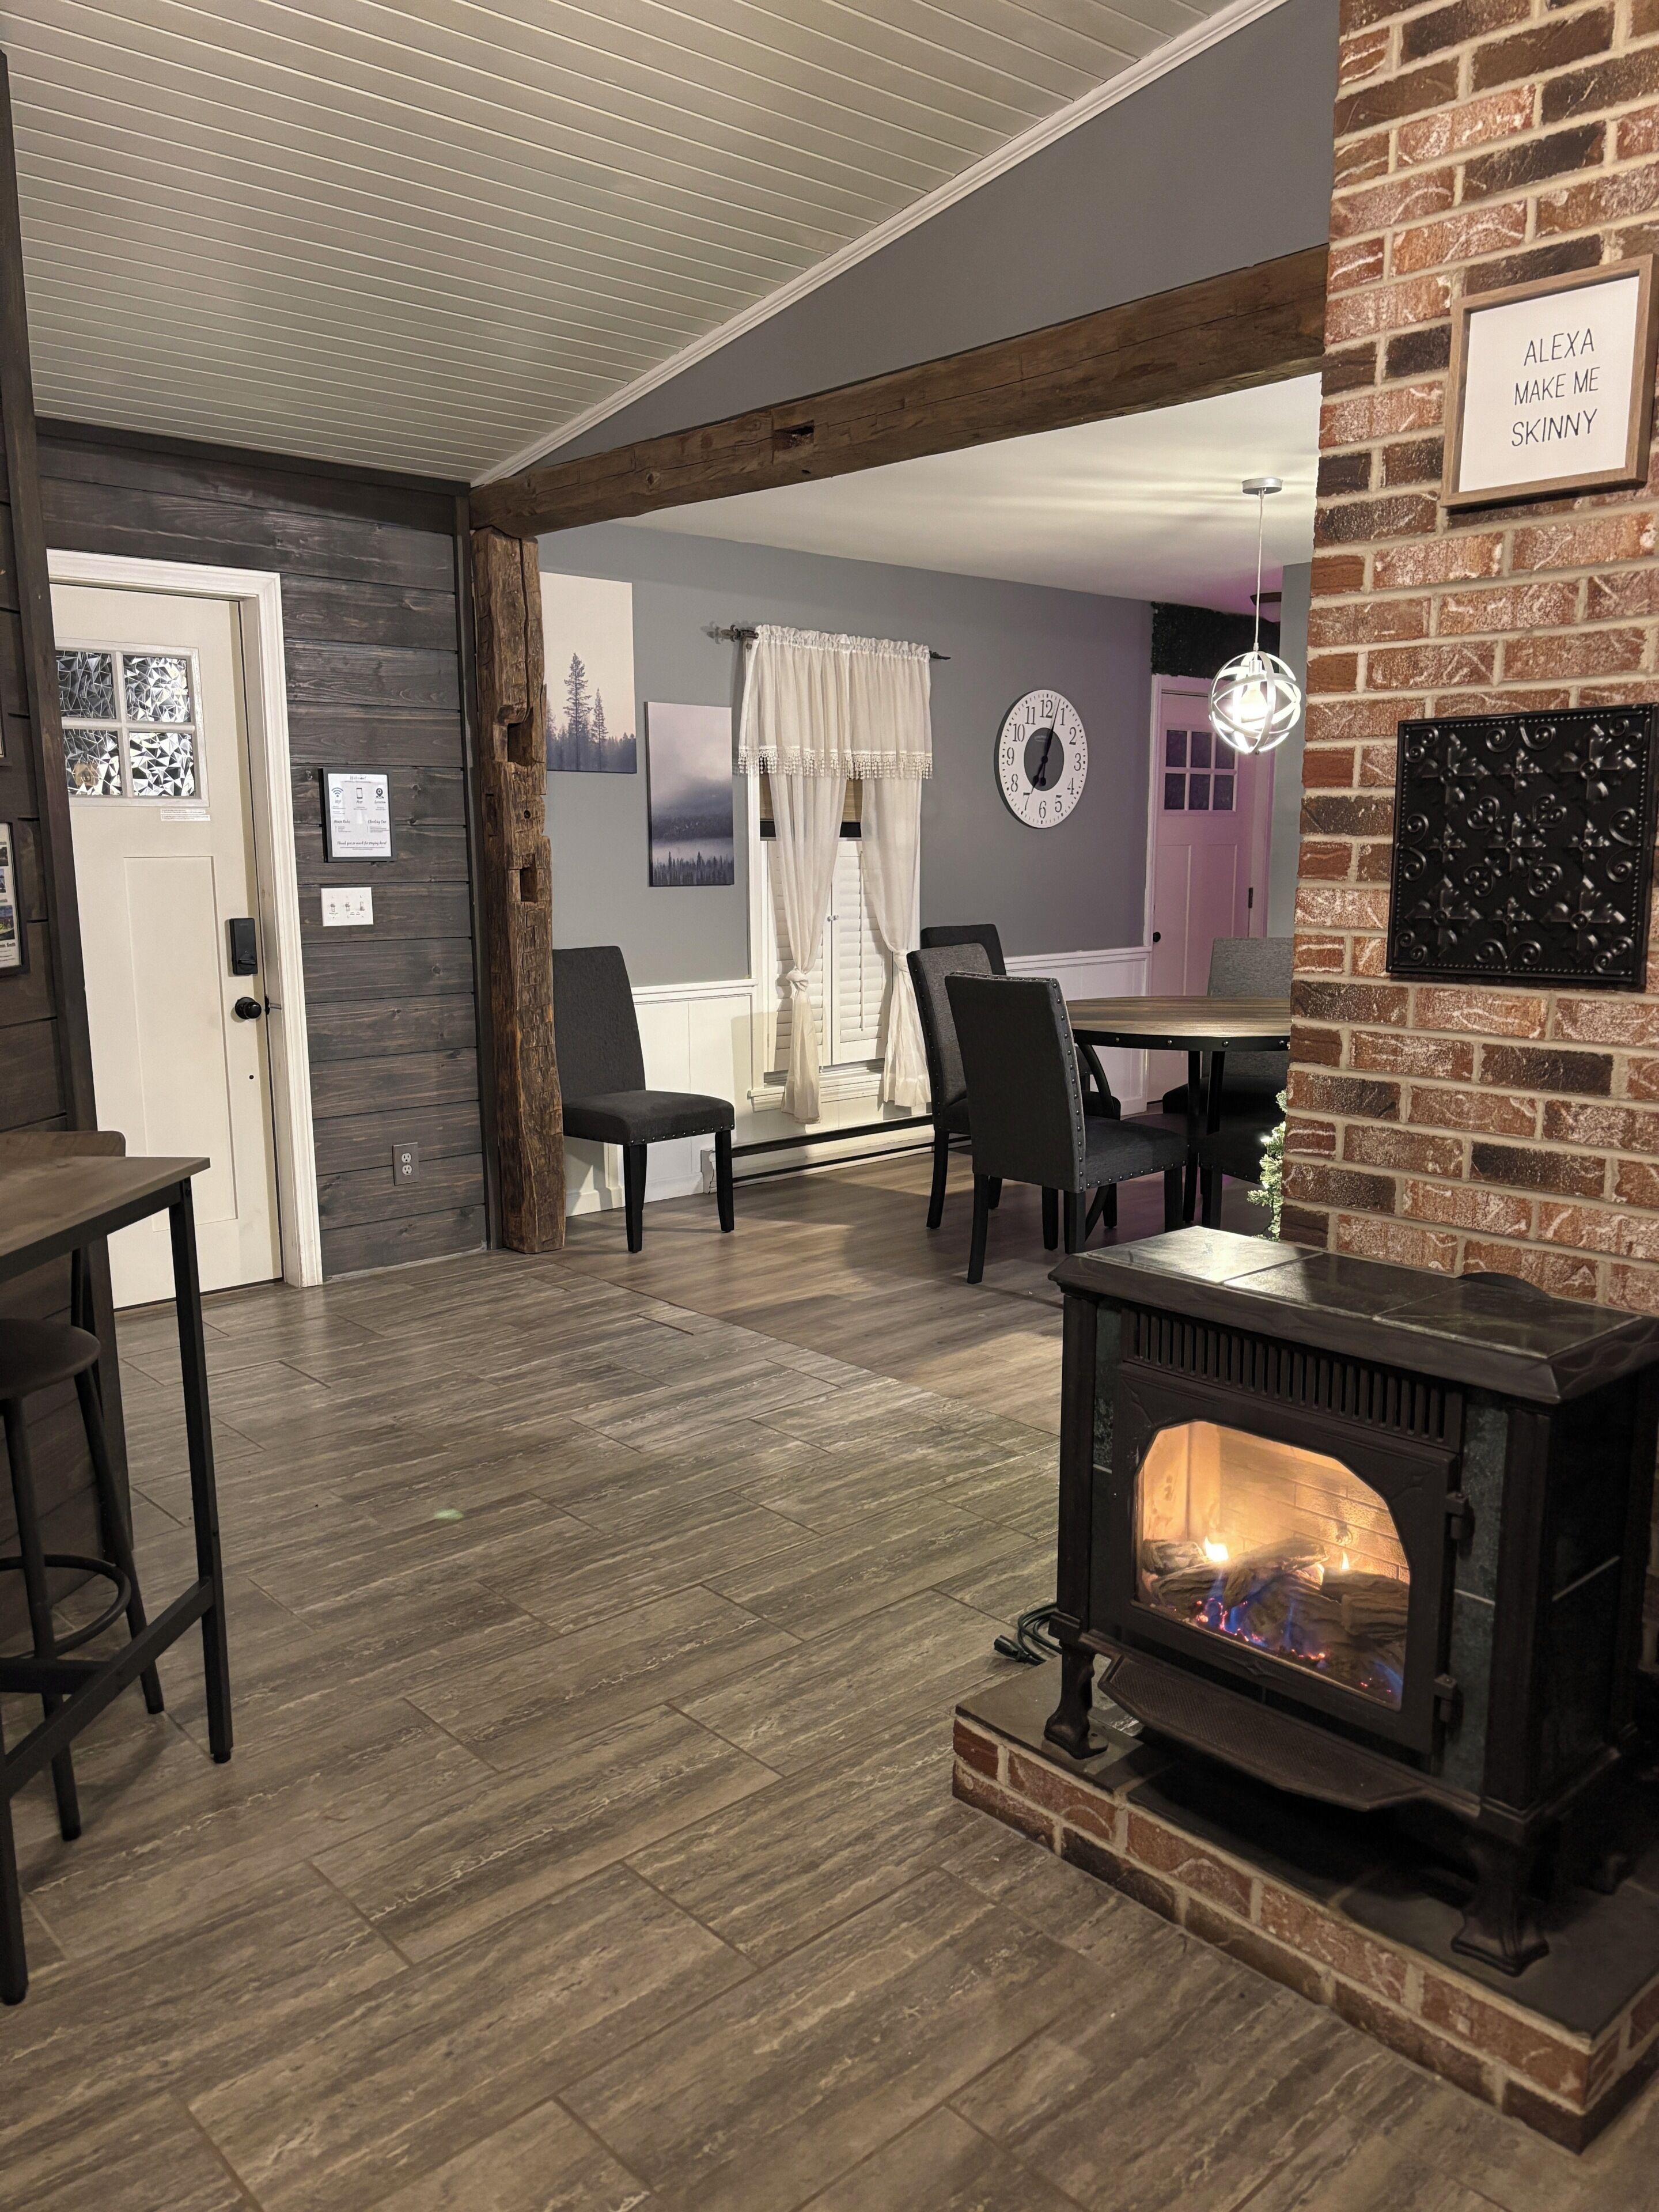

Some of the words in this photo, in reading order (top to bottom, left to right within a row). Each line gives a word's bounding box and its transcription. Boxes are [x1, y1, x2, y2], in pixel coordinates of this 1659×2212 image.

[1524, 328, 1595, 366] ALEXA
[1514, 373, 1567, 406] MAKE
[1573, 367, 1601, 395] ME
[1512, 408, 1598, 447] SKINNY
[1025, 706, 1037, 725] 11
[1039, 699, 1053, 719] 12
[1059, 707, 1066, 726] 1
[1012, 724, 1025, 743] 10
[1069, 726, 1077, 745] 2
[1006, 747, 1014, 766] 9
[1073, 752, 1082, 771] 3
[1010, 774, 1018, 793] 8
[1066, 777, 1075, 795] 4
[1023, 792, 1031, 811] 7
[1039, 800, 1047, 819] 6
[1055, 794, 1063, 813] 5
